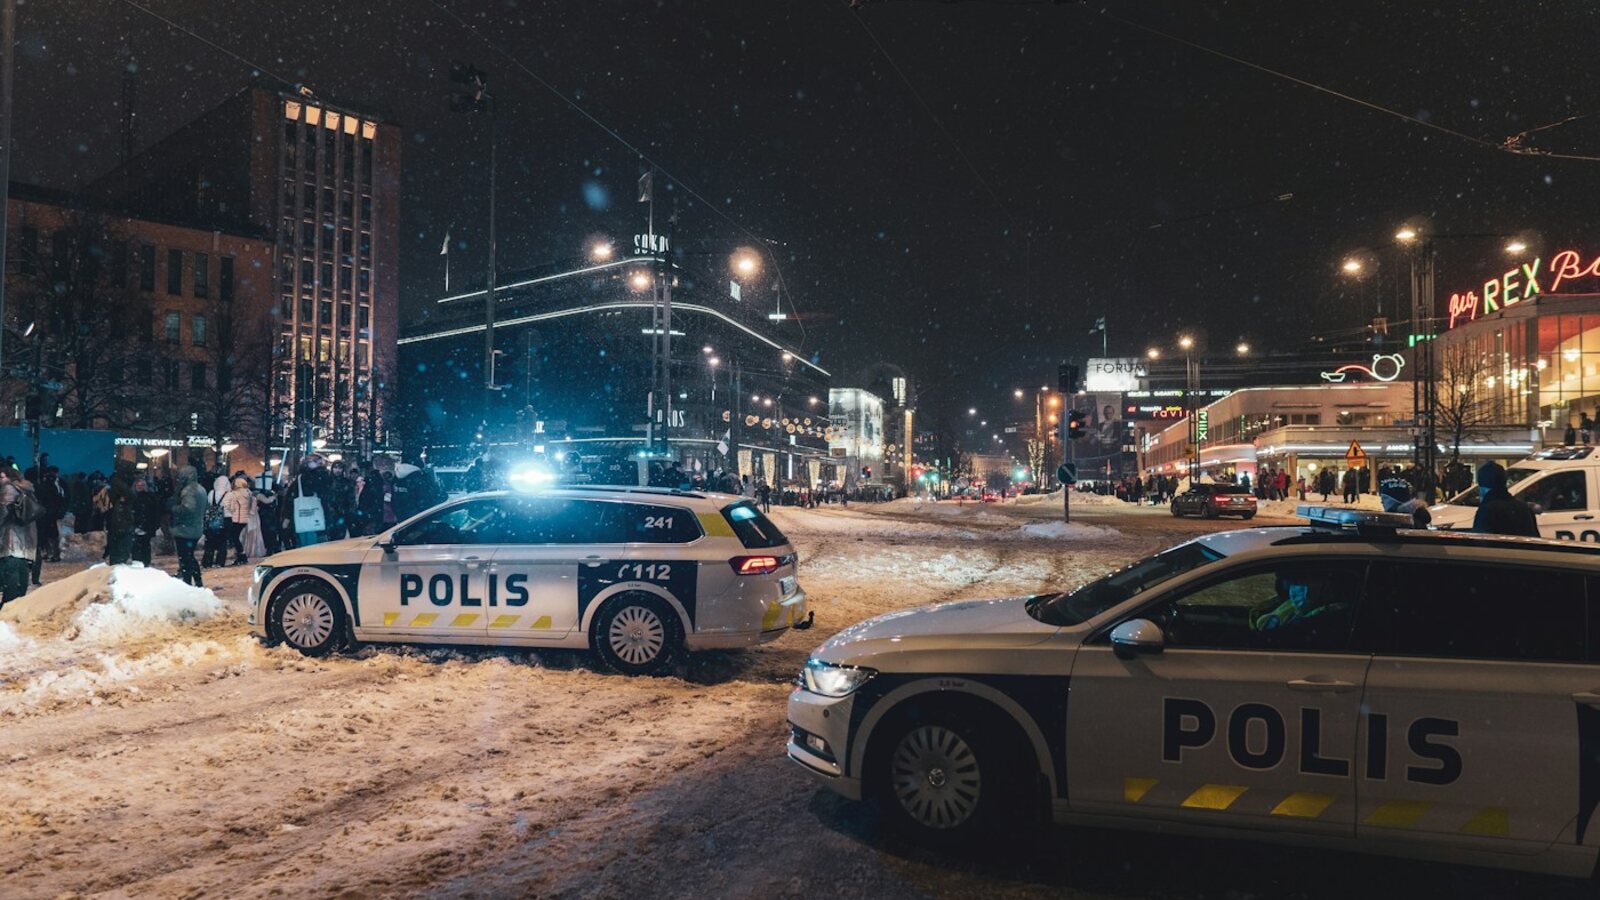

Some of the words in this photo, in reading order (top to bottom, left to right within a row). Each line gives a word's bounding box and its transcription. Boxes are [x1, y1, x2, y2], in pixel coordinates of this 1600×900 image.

[1484, 257, 1540, 315] REX
[1096, 363, 1147, 375] FORUM
[1198, 411, 1208, 440] REX
[644, 516, 673, 529] 241
[632, 564, 671, 580] 112
[400, 573, 529, 607] POLIS
[1161, 696, 1463, 785] POLIS
